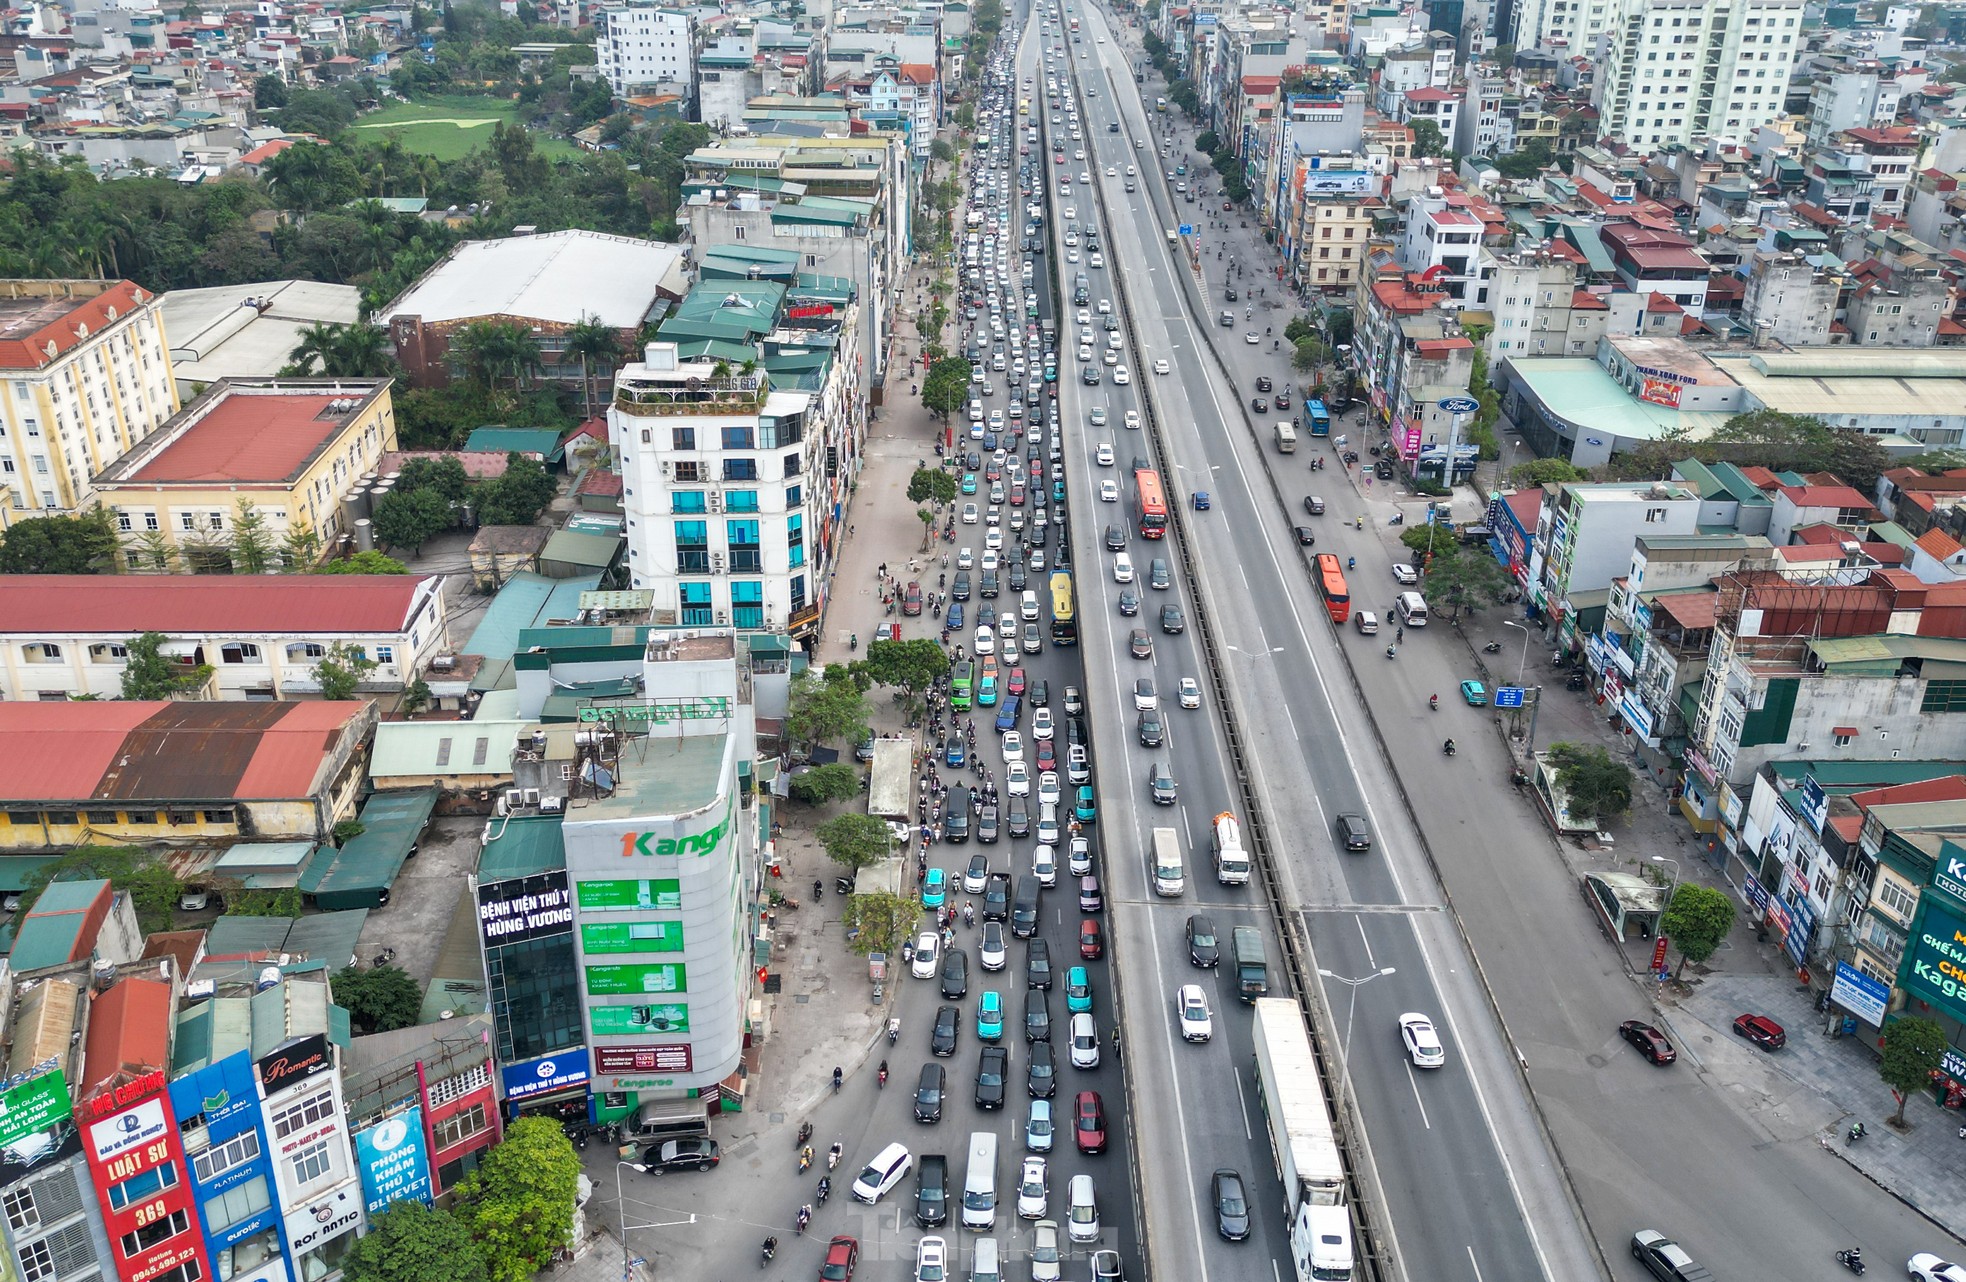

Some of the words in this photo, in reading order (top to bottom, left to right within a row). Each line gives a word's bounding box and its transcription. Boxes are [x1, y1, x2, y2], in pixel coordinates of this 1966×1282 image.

[1678, 375, 1698, 386] FORD
[1445, 400, 1472, 410] Ford
[1947, 857, 1966, 882] K
[480, 901, 510, 921] BỆNH
[512, 895, 538, 914] VIỆN
[539, 889, 560, 908] THÚ
[562, 889, 569, 904] Y
[486, 917, 525, 937] HÙNG
[527, 908, 572, 929] VƯƠNG
[1922, 933, 1953, 955] GHẾ
[263, 1053, 322, 1084] Romantic
[307, 1061, 329, 1074] Studio
[22, 1091, 49, 1107] GLASS
[293, 1082, 308, 1093] 369
[14, 1110, 28, 1121] AN
[29, 1097, 56, 1113] TOÀN
[3, 1119, 20, 1135] HẢI
[22, 1110, 48, 1126] LONG
[107, 1152, 142, 1181] LUẬT
[147, 1138, 168, 1164] SƯ
[370, 1143, 416, 1172] PHÒNG
[375, 1157, 415, 1183] KHÁM
[213, 1166, 253, 1189] PLATINUM
[376, 1174, 403, 1194] THÚ
[407, 1169, 415, 1180] Y
[135, 1199, 166, 1226] 369
[132, 1246, 195, 1282] 0945.490.123
[148, 1249, 173, 1264] Hotline
